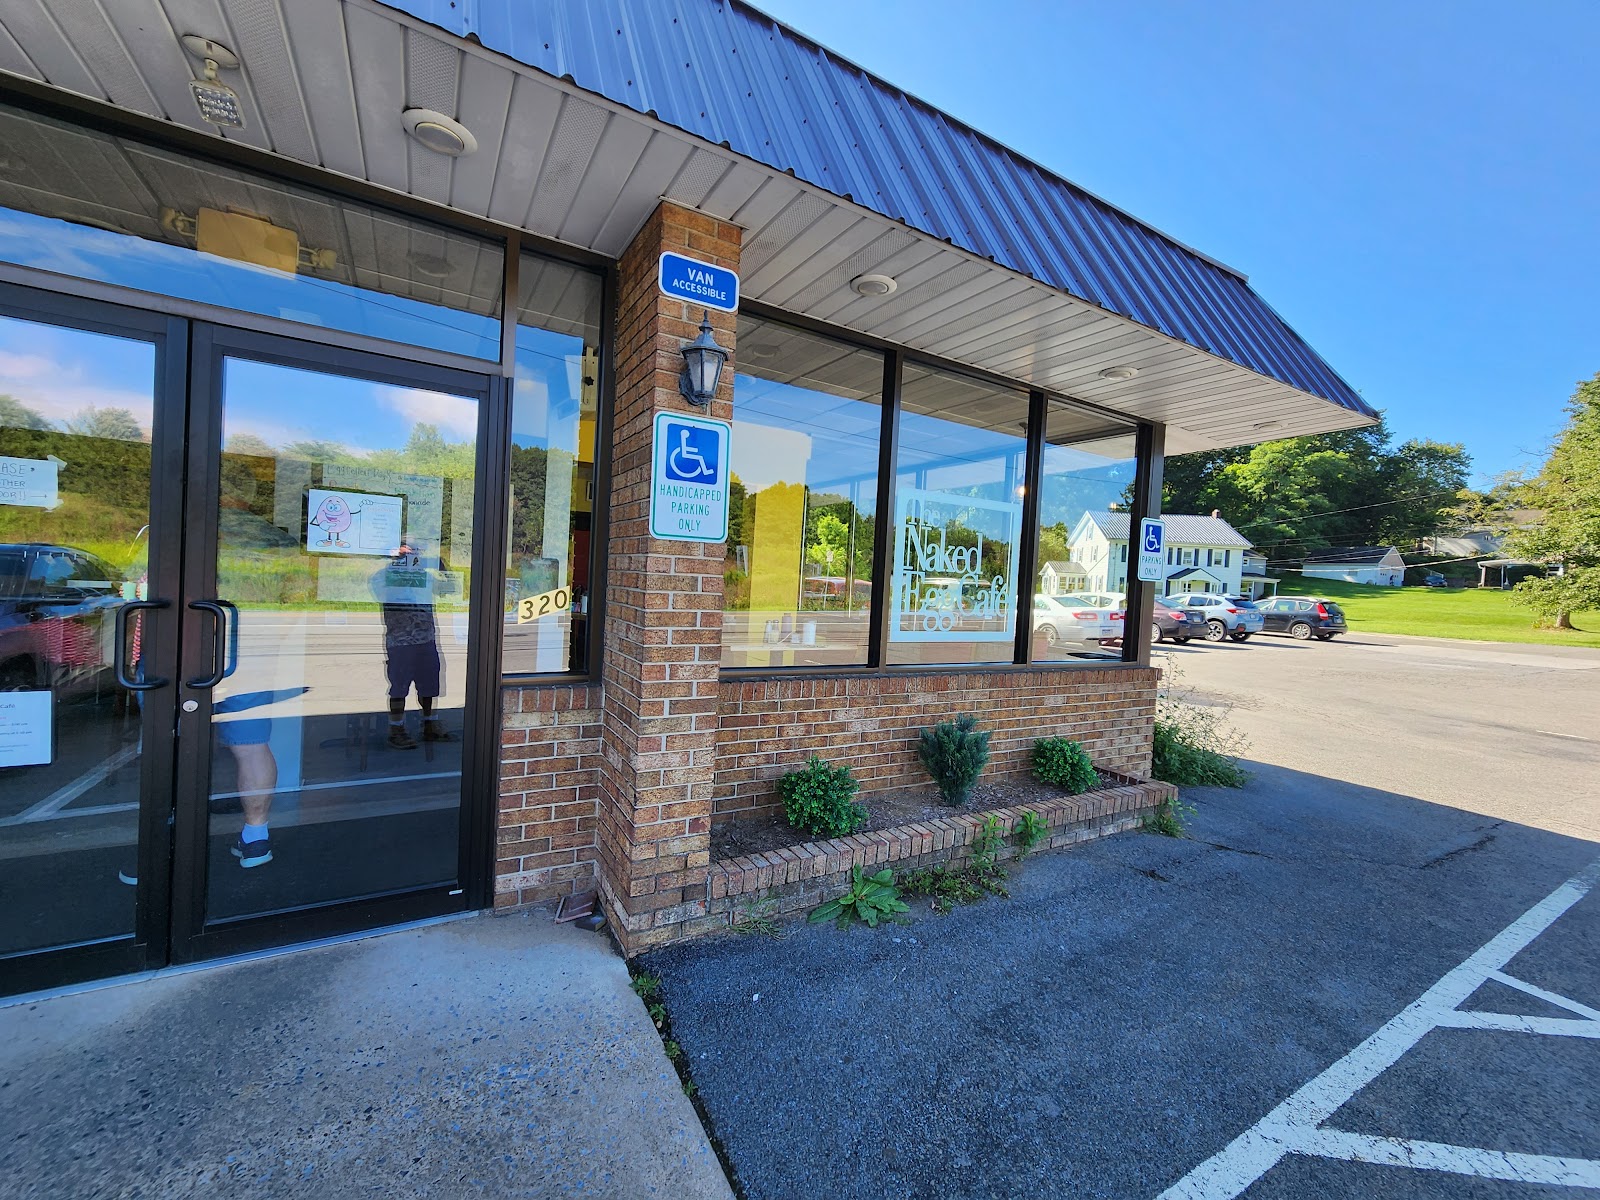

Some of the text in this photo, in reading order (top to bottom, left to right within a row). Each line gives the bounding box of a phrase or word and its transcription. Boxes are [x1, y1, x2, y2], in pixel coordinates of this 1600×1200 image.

[687, 267, 714, 286] VAN
[672, 278, 727, 301] ACCESSIBLE
[660, 484, 722, 502] HANDICAPPED
[671, 501, 710, 516] PARKING
[905, 498, 941, 528] The
[678, 518, 701, 532] ONLY
[902, 525, 983, 575] Naked
[1144, 567, 1157, 576] ONLY
[520, 589, 568, 620] 320
[900, 571, 1010, 632] Egg Café
